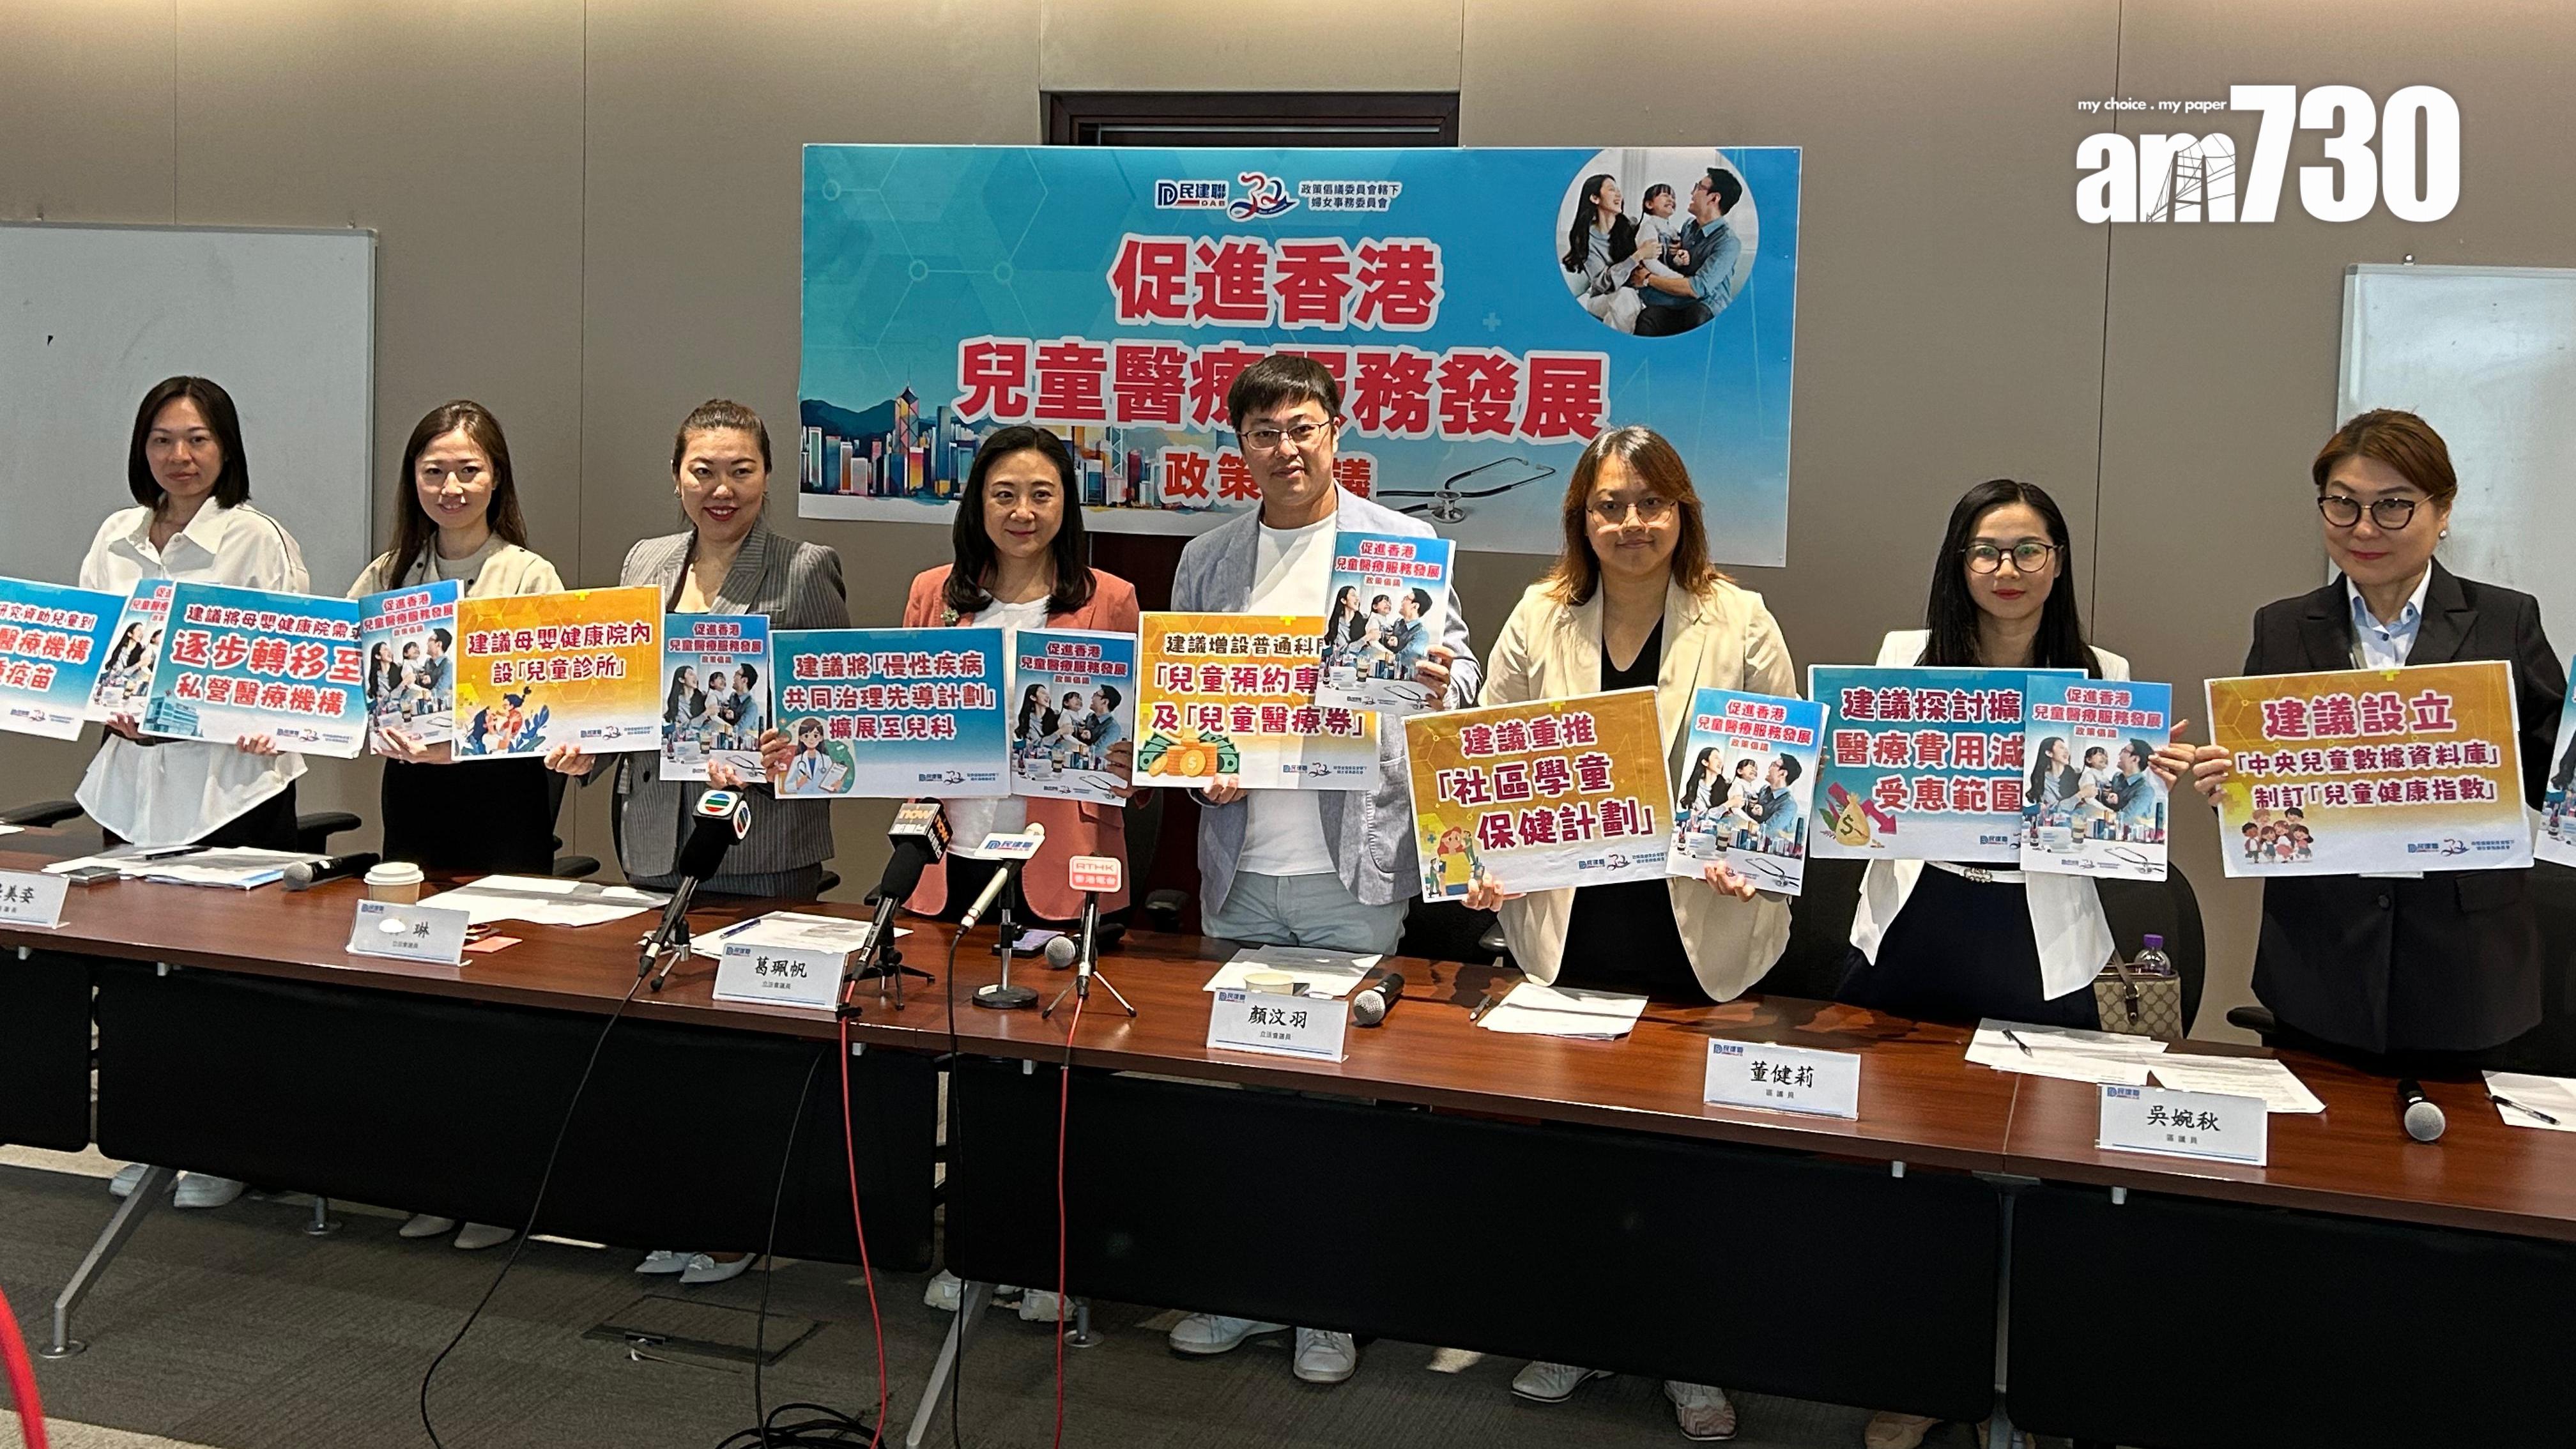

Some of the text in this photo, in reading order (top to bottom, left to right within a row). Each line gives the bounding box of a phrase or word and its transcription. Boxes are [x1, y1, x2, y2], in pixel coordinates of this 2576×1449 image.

[1113, 238, 1437, 326] 促進香港
[1361, 542, 1414, 558] 促進香港
[1336, 558, 1441, 578] 兒童醫療服務發展
[384, 593, 429, 611] 促進香港
[468, 622, 650, 654] 建議母嬰健康院內
[694, 623, 739, 635] 促進香港
[172, 632, 362, 682] 逐步轉移至
[1047, 643, 1101, 657] 促進香港
[493, 654, 625, 684] 設「兒童診所」
[796, 652, 984, 679] 建議將「慢性疾病
[177, 675, 344, 716] 私營醫療機構
[785, 686, 995, 710] 共同治理先導計劃」
[1842, 688, 2021, 721] 建議探討擴
[2067, 688, 2130, 707] 促進香港
[1728, 702, 1785, 721] 促進香港
[2034, 705, 2162, 728] 兒童醫療服務發展
[2264, 693, 2454, 738] 建議設立
[829, 716, 955, 740] 擴展至兒科
[1461, 714, 1596, 756] 建議重推
[1698, 716, 1812, 744] 兒童醫療服務發展
[1834, 732, 2025, 767] 醫療費用減
[2237, 742, 2499, 776] 「中央兒童數據資料庫」
[1438, 755, 1611, 805] 「社區學童
[2255, 777, 2496, 808] 制訂「兒童健康指數」
[1875, 777, 2023, 812] 受惠範圍
[1477, 799, 1653, 850] 保健計劃」
[1076, 862, 1114, 871] RTHK
[755, 956, 808, 978] 葛珮帆
[1248, 1005, 1308, 1029] 顏汶羽
[1750, 1061, 1814, 1089] 董健莉
[2147, 1105, 2221, 1131] 吳婉秋
